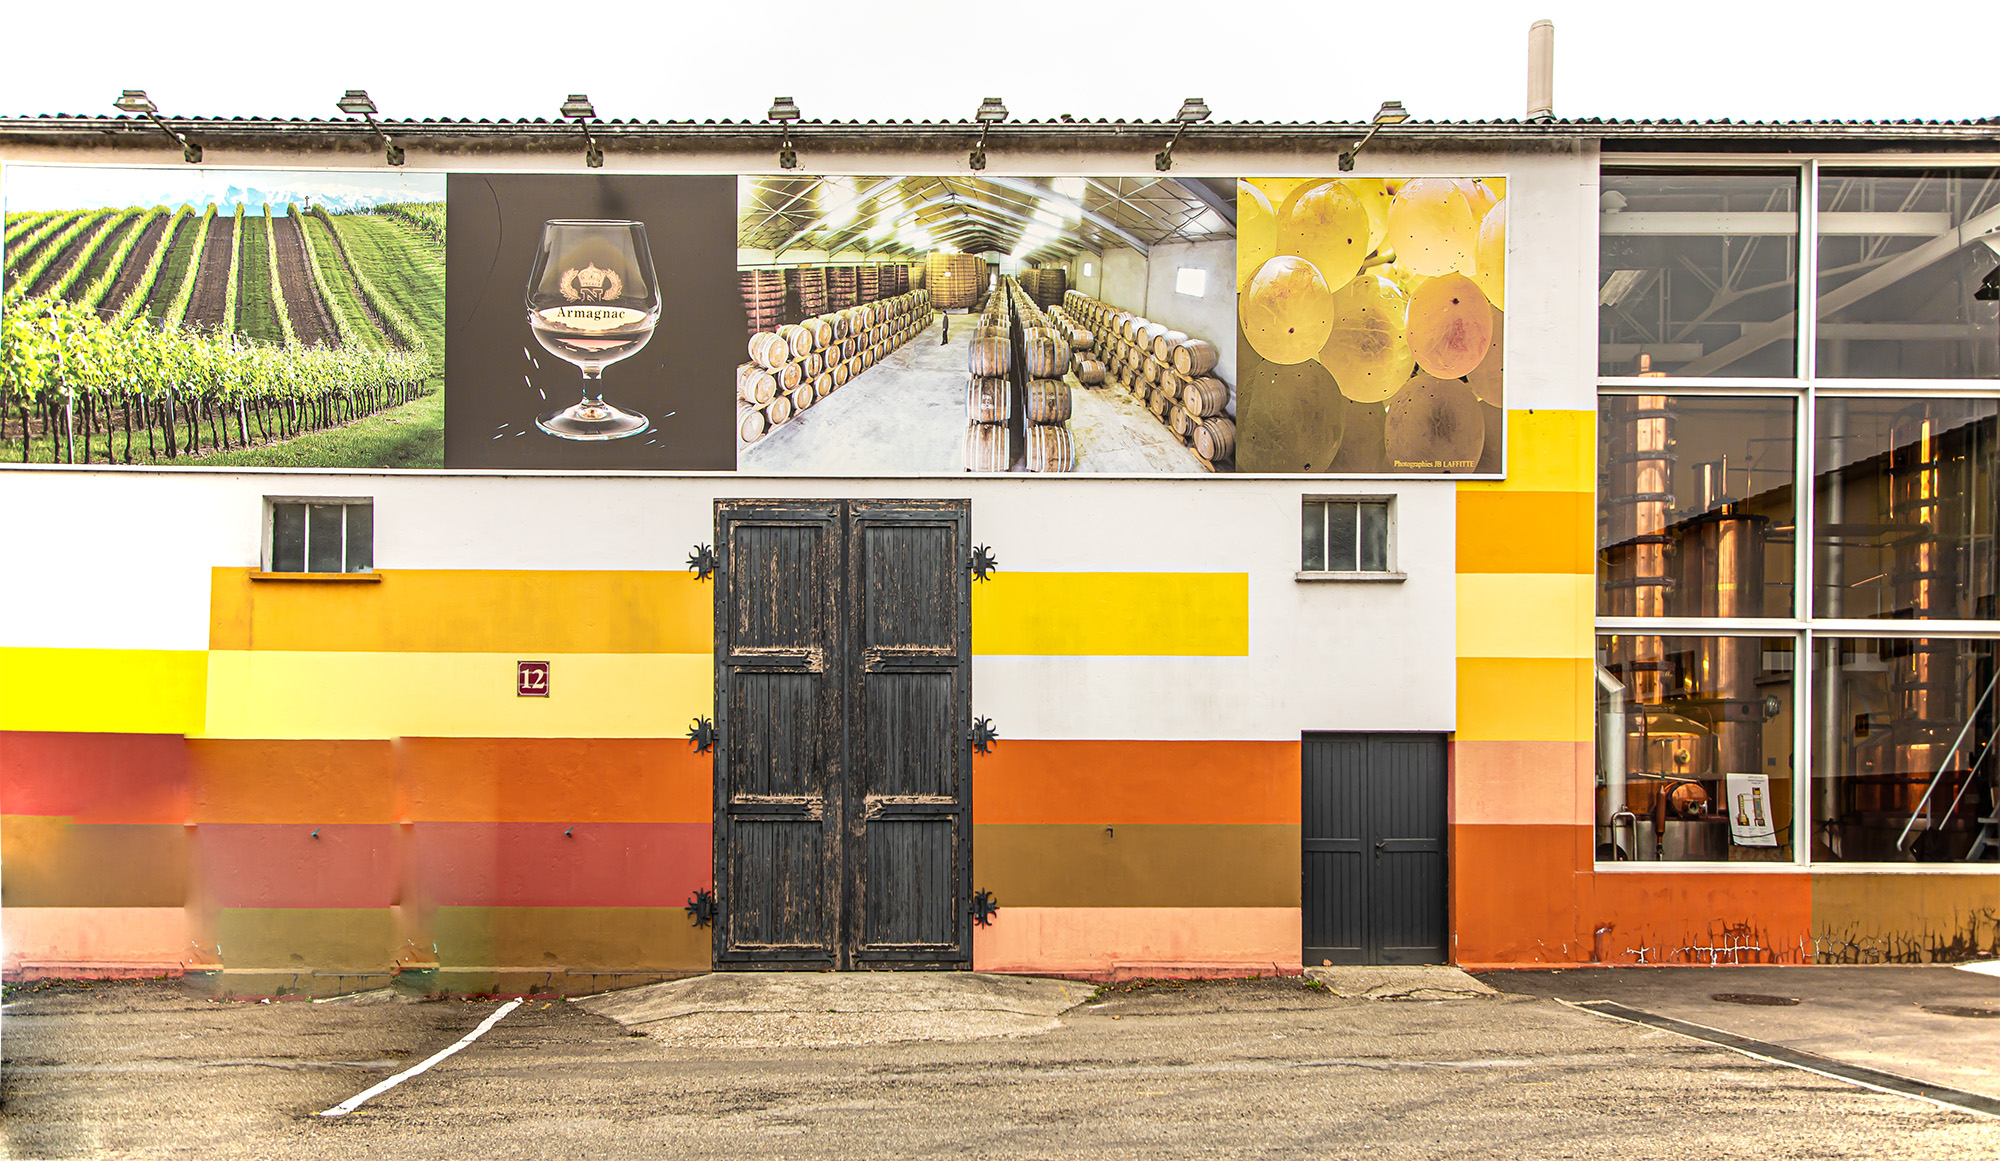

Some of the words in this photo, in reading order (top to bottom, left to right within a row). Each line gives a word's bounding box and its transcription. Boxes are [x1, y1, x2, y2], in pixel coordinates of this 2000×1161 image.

[557, 306, 626, 321] Armagnac
[1393, 460, 1433, 469] Photographies
[1434, 460, 1442, 468] JB
[1443, 460, 1475, 468] LAFFITTE
[521, 668, 545, 689] 12
